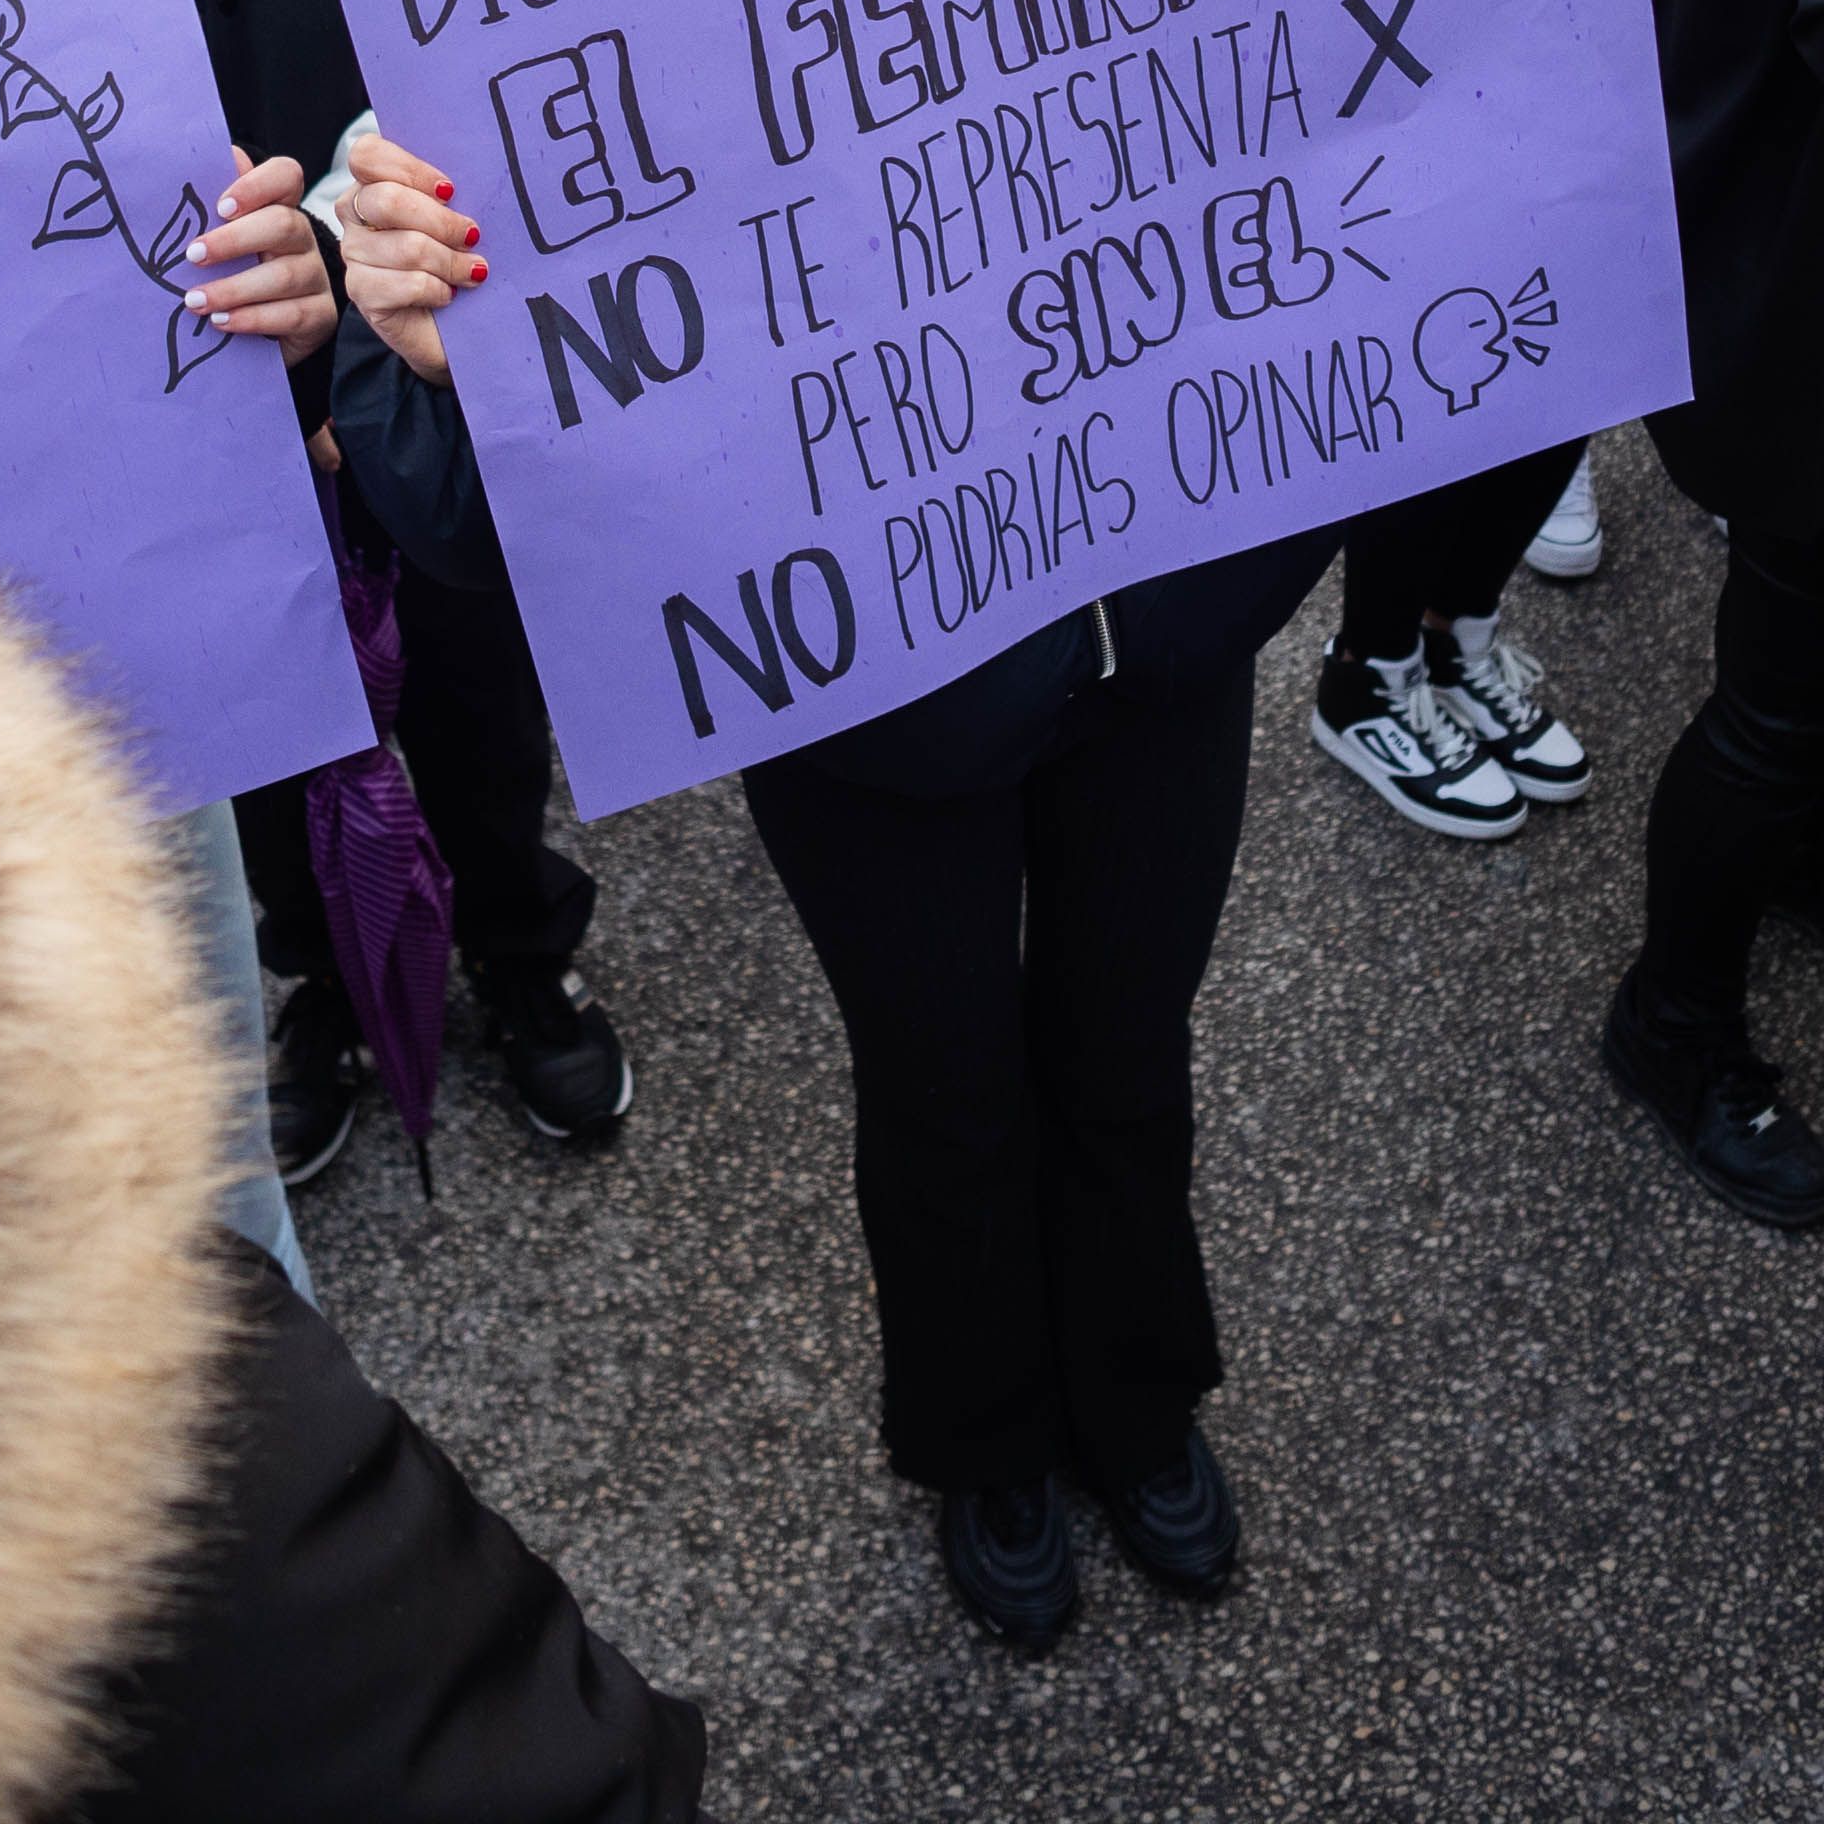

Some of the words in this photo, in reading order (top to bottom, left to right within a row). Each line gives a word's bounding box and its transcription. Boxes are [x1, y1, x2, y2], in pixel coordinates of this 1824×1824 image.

[488, 28, 697, 255] EL
[525, 255, 707, 431] NO
[740, 195, 836, 348] TE
[879, 11, 1310, 310] REPRESENTA
[791, 323, 974, 516] PERO
[1007, 221, 1187, 405] SIN
[1203, 177, 1336, 321] EL
[661, 547, 857, 739] NO
[885, 411, 1136, 649] PODRÍAS
[1167, 333, 1406, 505] OPINAR
[1387, 730, 1412, 757] FILA
